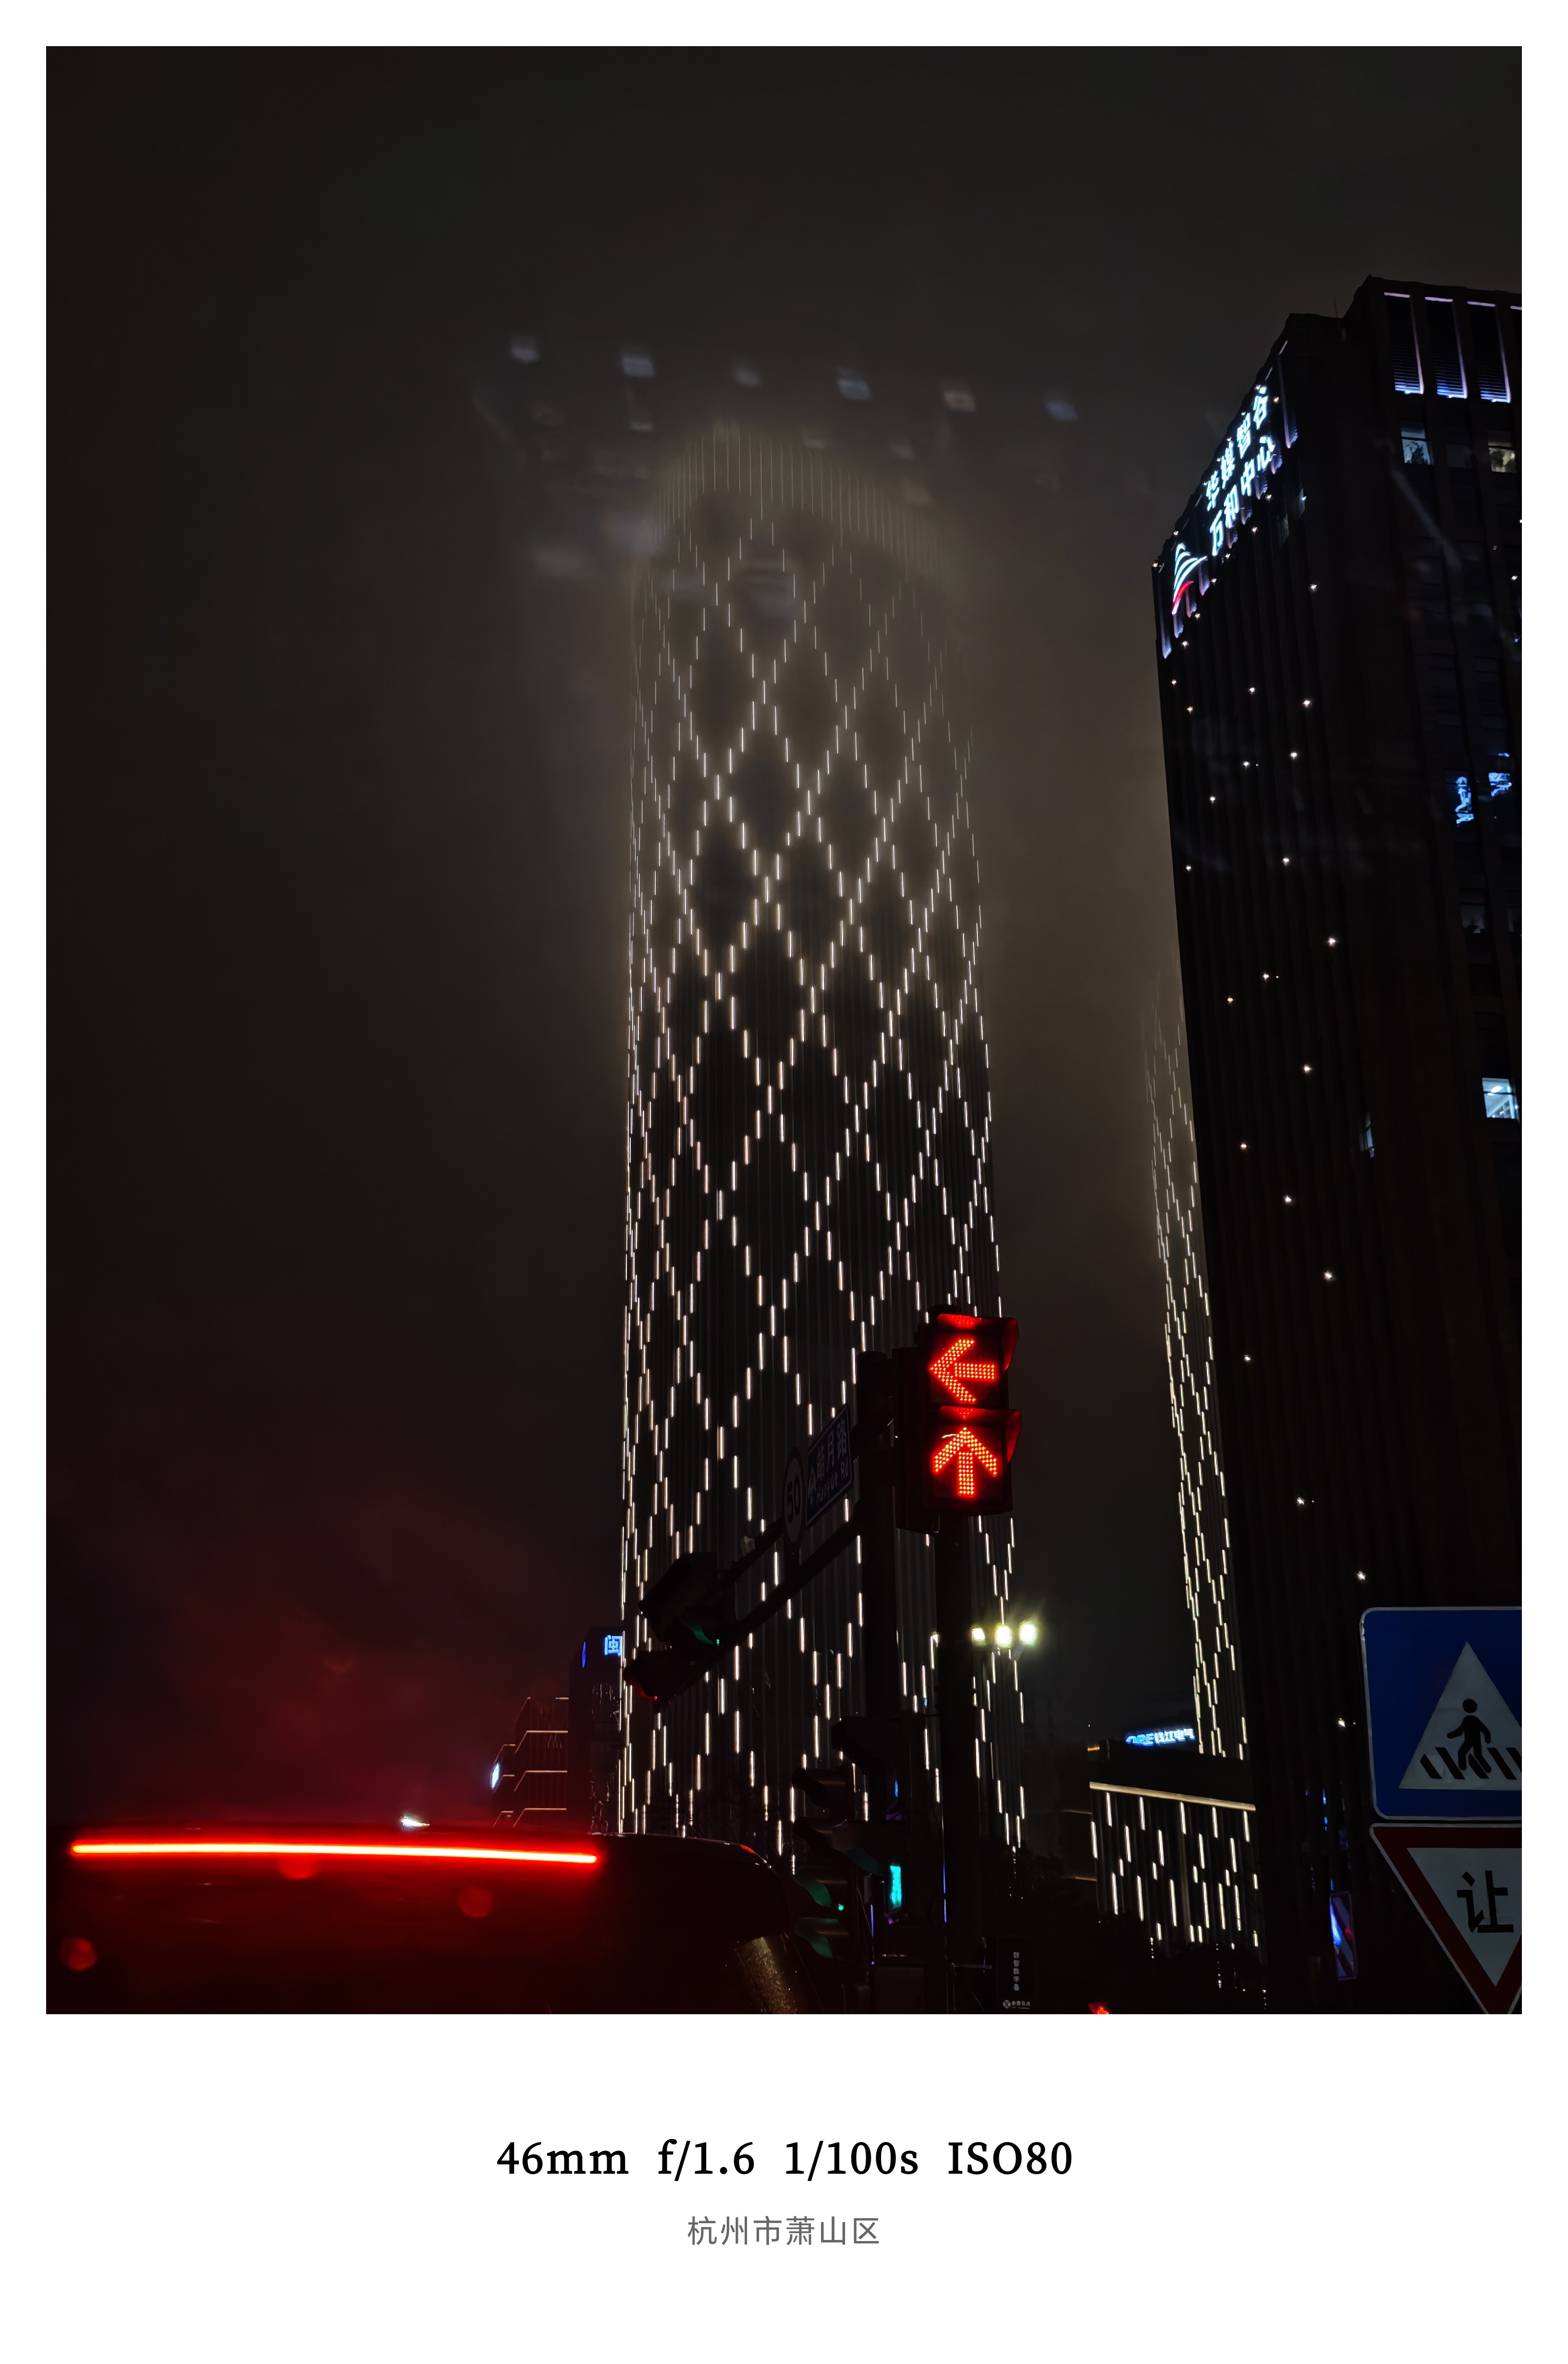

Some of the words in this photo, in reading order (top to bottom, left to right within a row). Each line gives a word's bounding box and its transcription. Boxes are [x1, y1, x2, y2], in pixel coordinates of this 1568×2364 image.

[1210, 436, 1275, 556] 万和中心
[841, 1456, 849, 1481] Rd
[787, 1475, 801, 1524] 50
[604, 1635, 623, 1657] 闽
[1456, 1870, 1514, 1933] 让
